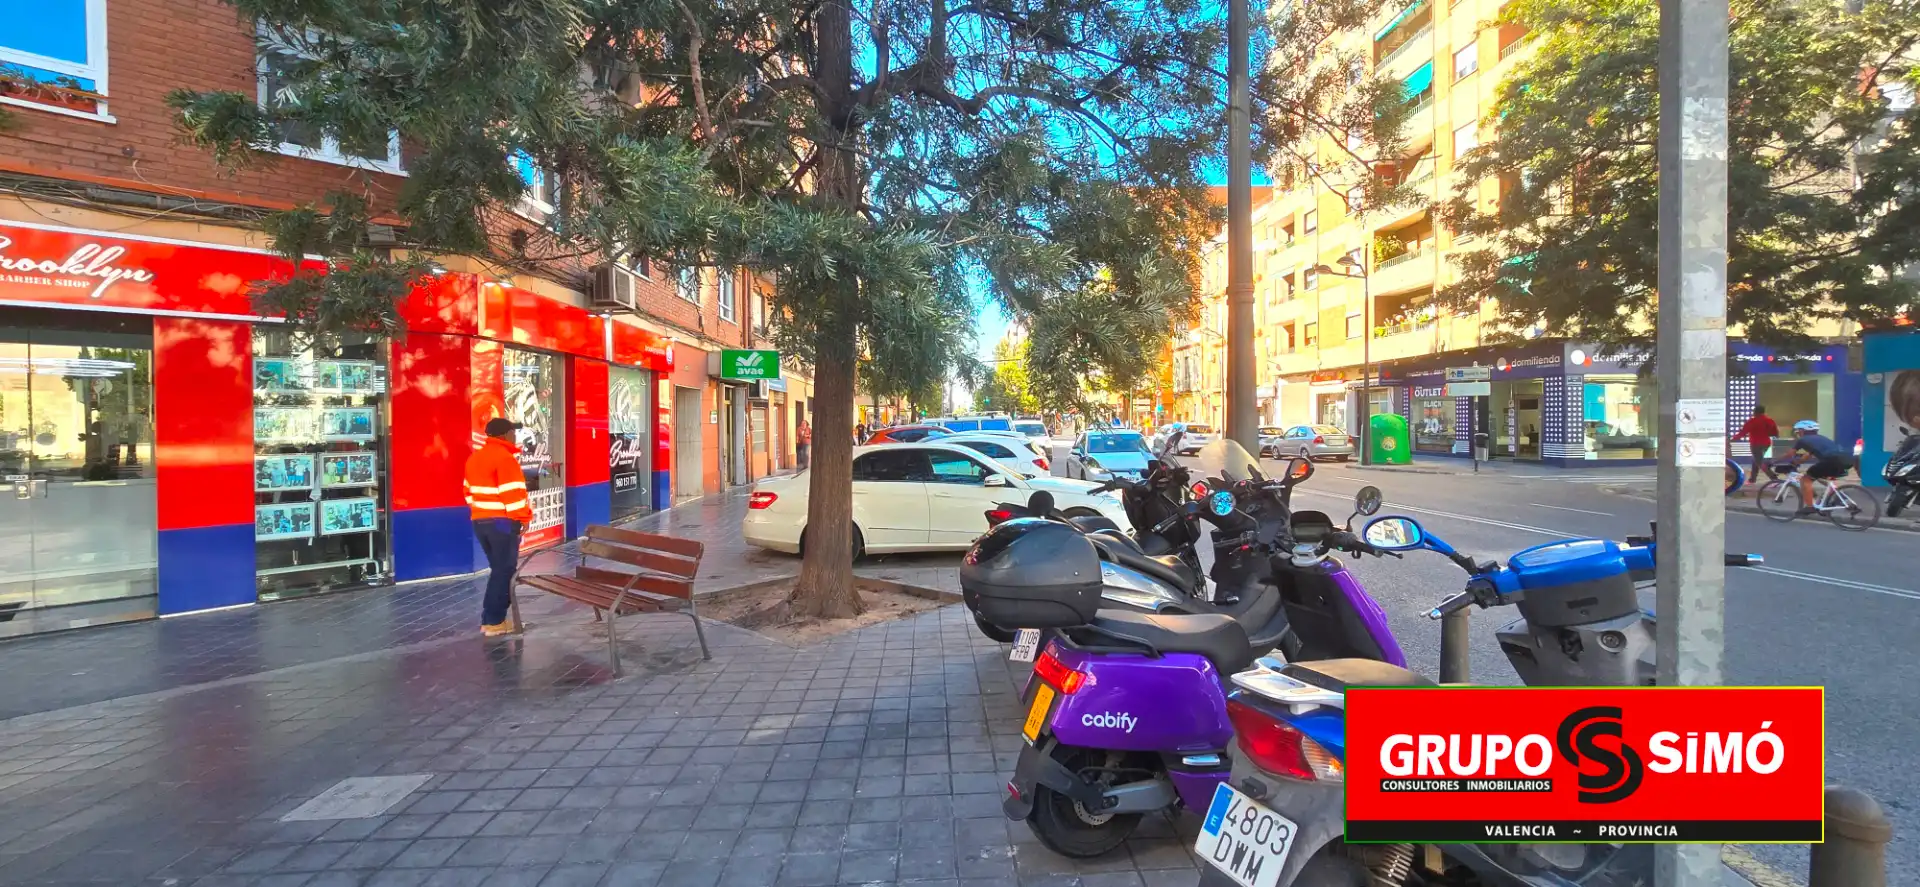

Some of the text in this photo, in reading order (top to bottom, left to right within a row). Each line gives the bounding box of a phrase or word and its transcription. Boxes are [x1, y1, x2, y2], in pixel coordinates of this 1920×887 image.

[54, 279, 91, 288] SHOP
[1511, 355, 1561, 368] dormitienda
[736, 367, 764, 375] avae
[1414, 387, 1442, 397] OUTLET
[1423, 400, 1443, 408] BLACK
[1081, 711, 1138, 733] cabify
[1225, 798, 1290, 856] 4803
[1213, 831, 1265, 886] DWM
